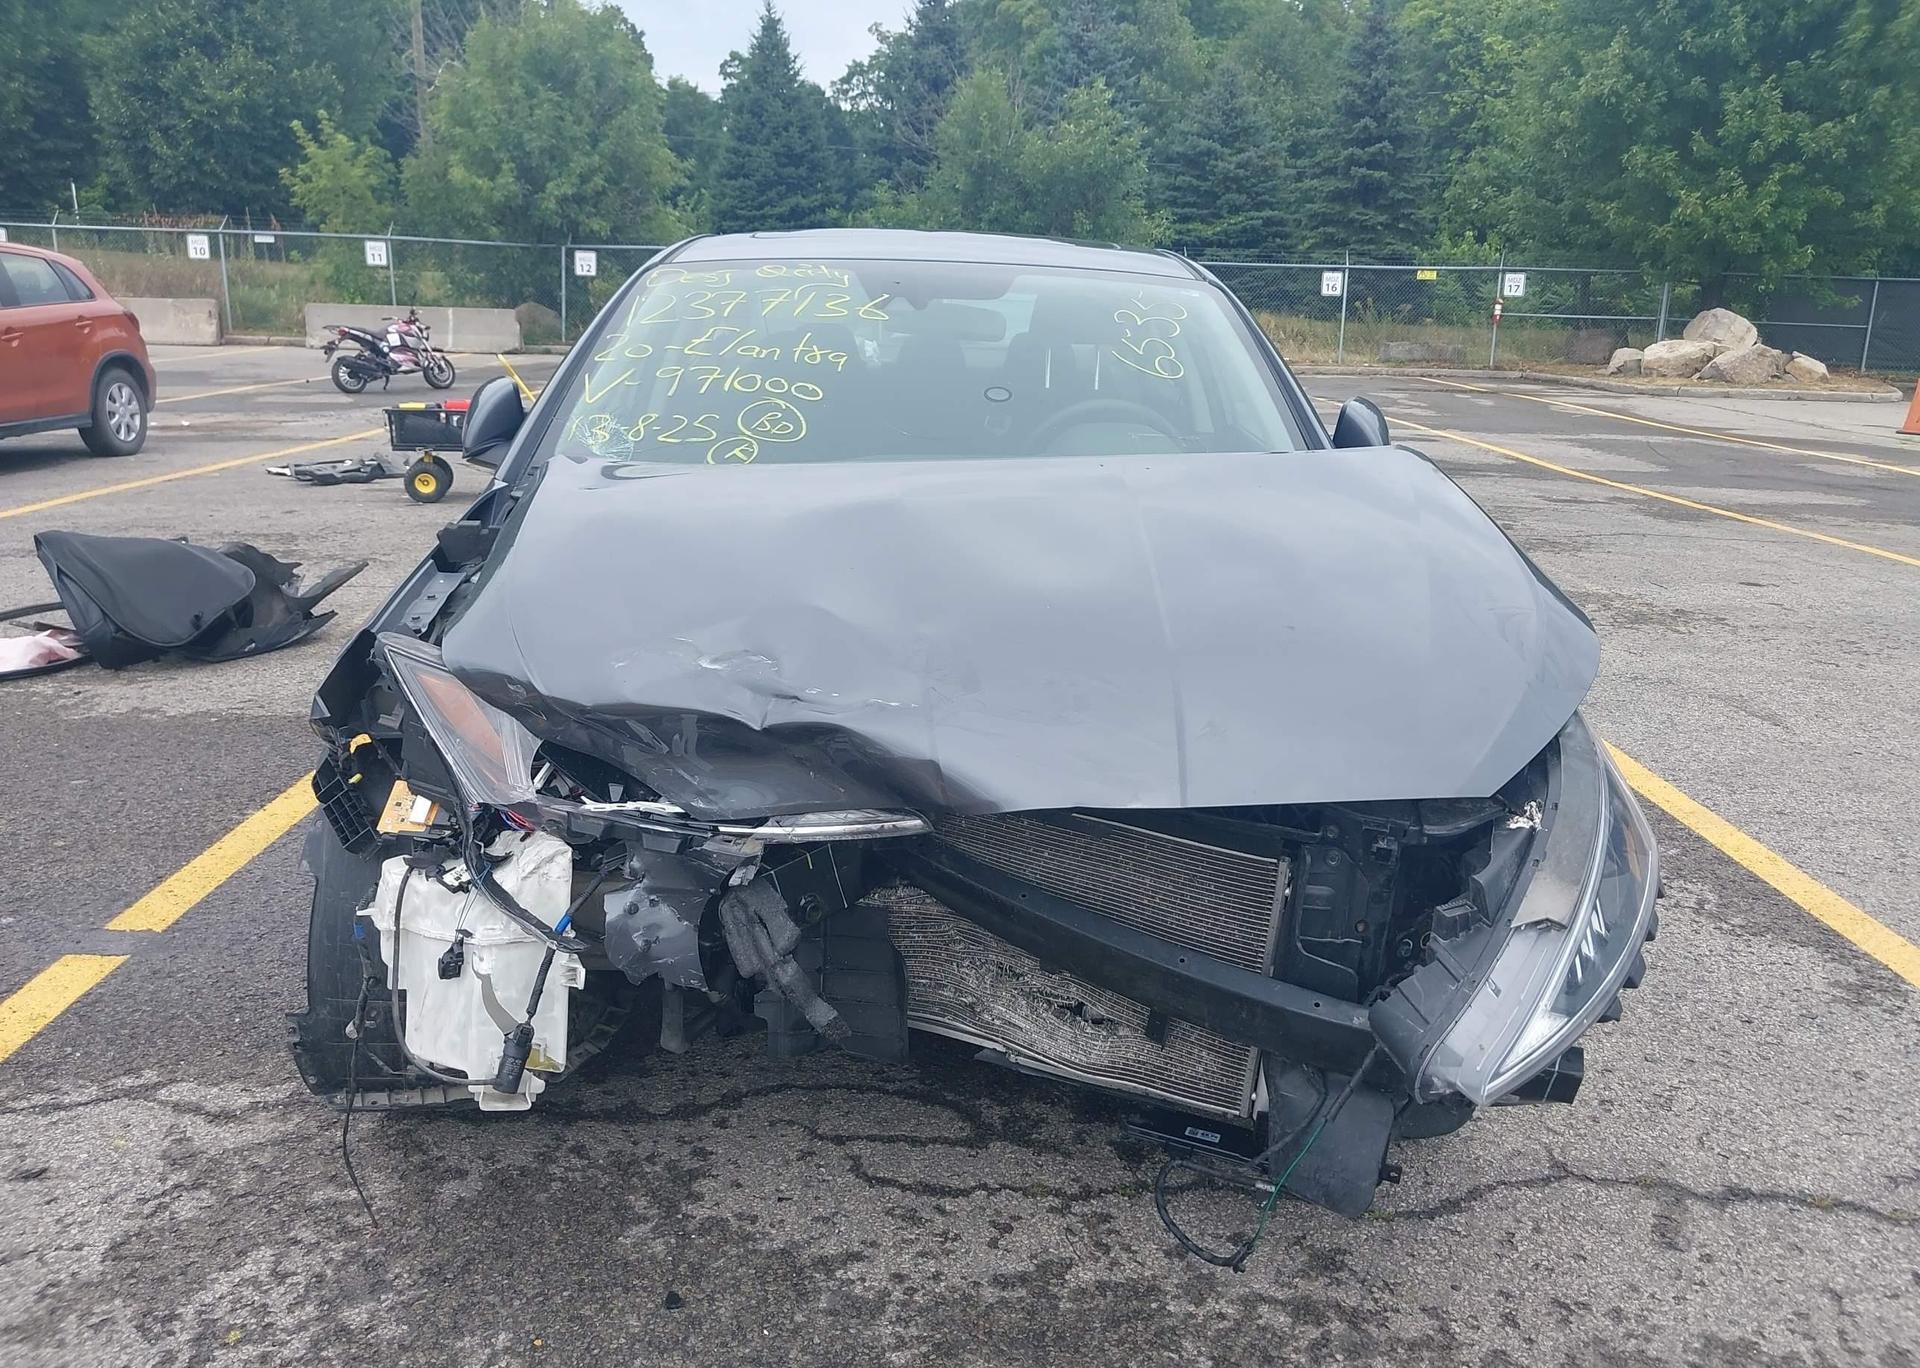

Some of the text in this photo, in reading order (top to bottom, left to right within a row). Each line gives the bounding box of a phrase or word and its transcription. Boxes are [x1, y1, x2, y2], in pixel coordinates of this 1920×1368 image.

[193, 247, 206, 256] 10
[371, 252, 382, 262] 11
[580, 263, 592, 273] 12
[1325, 283, 1338, 292] 16
[1508, 284, 1521, 293] 17
